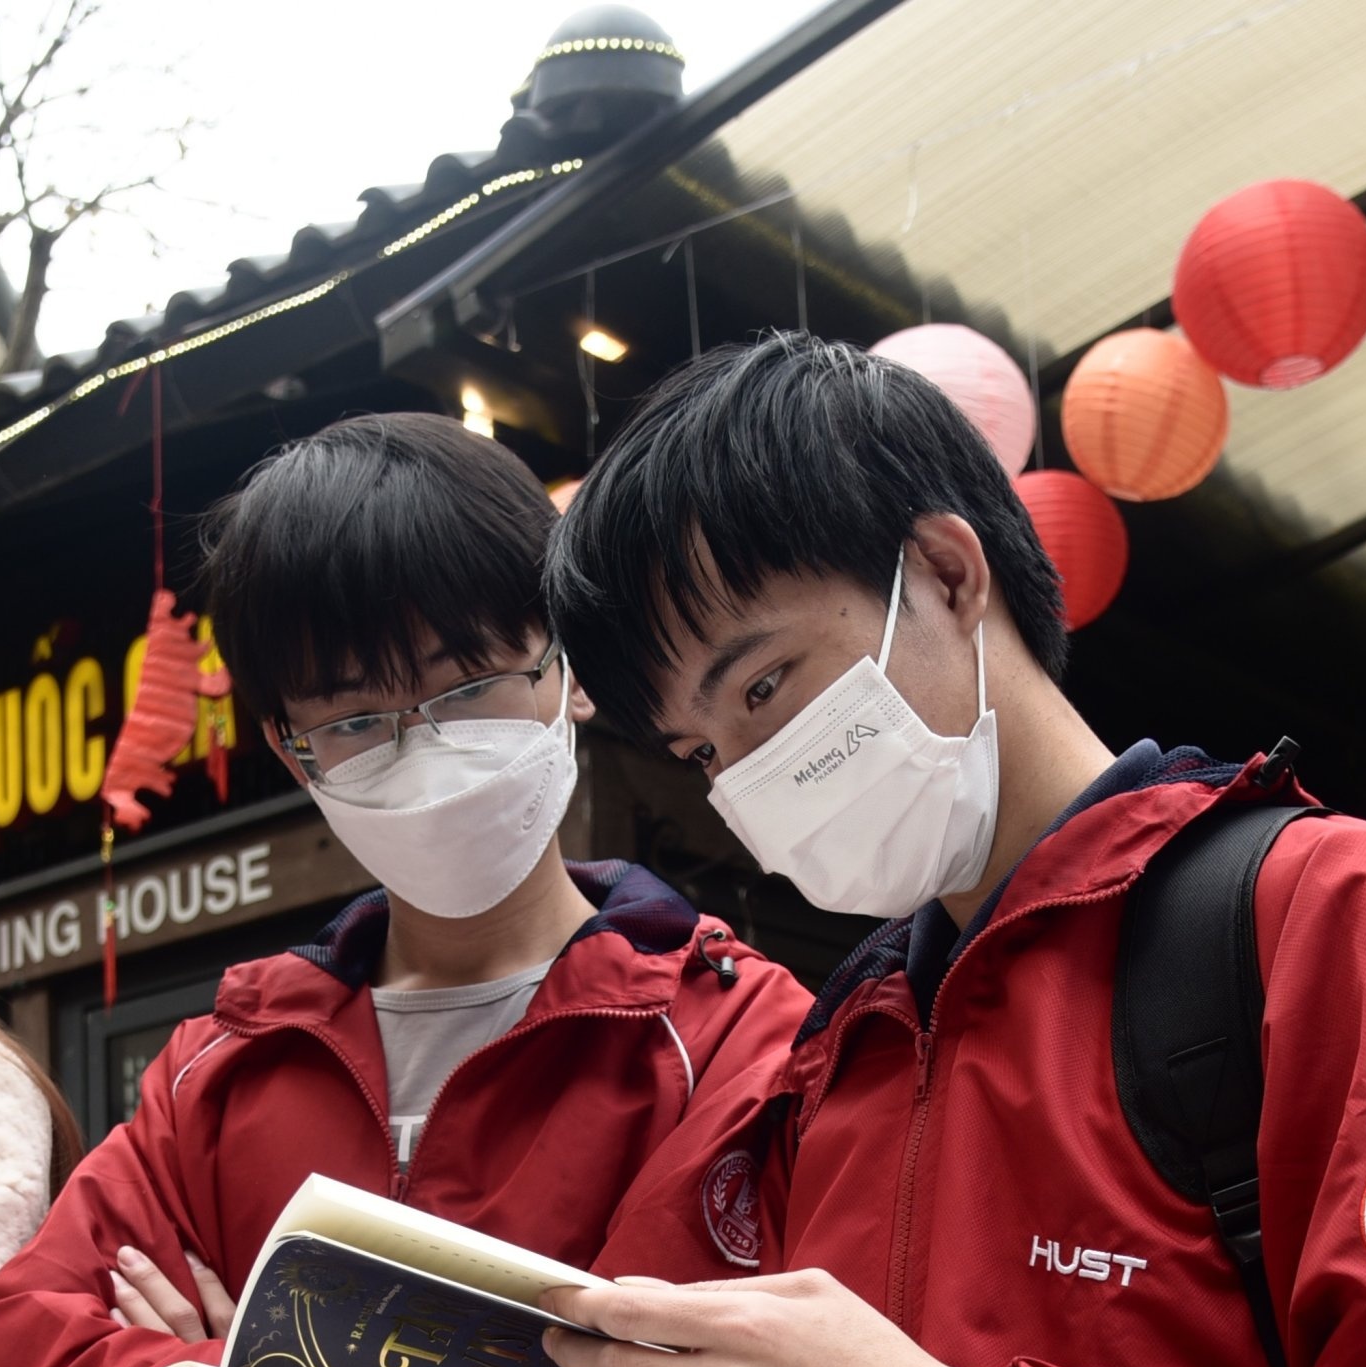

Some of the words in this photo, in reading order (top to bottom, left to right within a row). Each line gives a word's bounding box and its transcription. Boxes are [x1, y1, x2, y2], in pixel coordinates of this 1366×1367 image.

[813, 759, 846, 784] PHARMA
[97, 842, 273, 944] HOUSE
[1029, 1234, 1147, 1289] HUST
